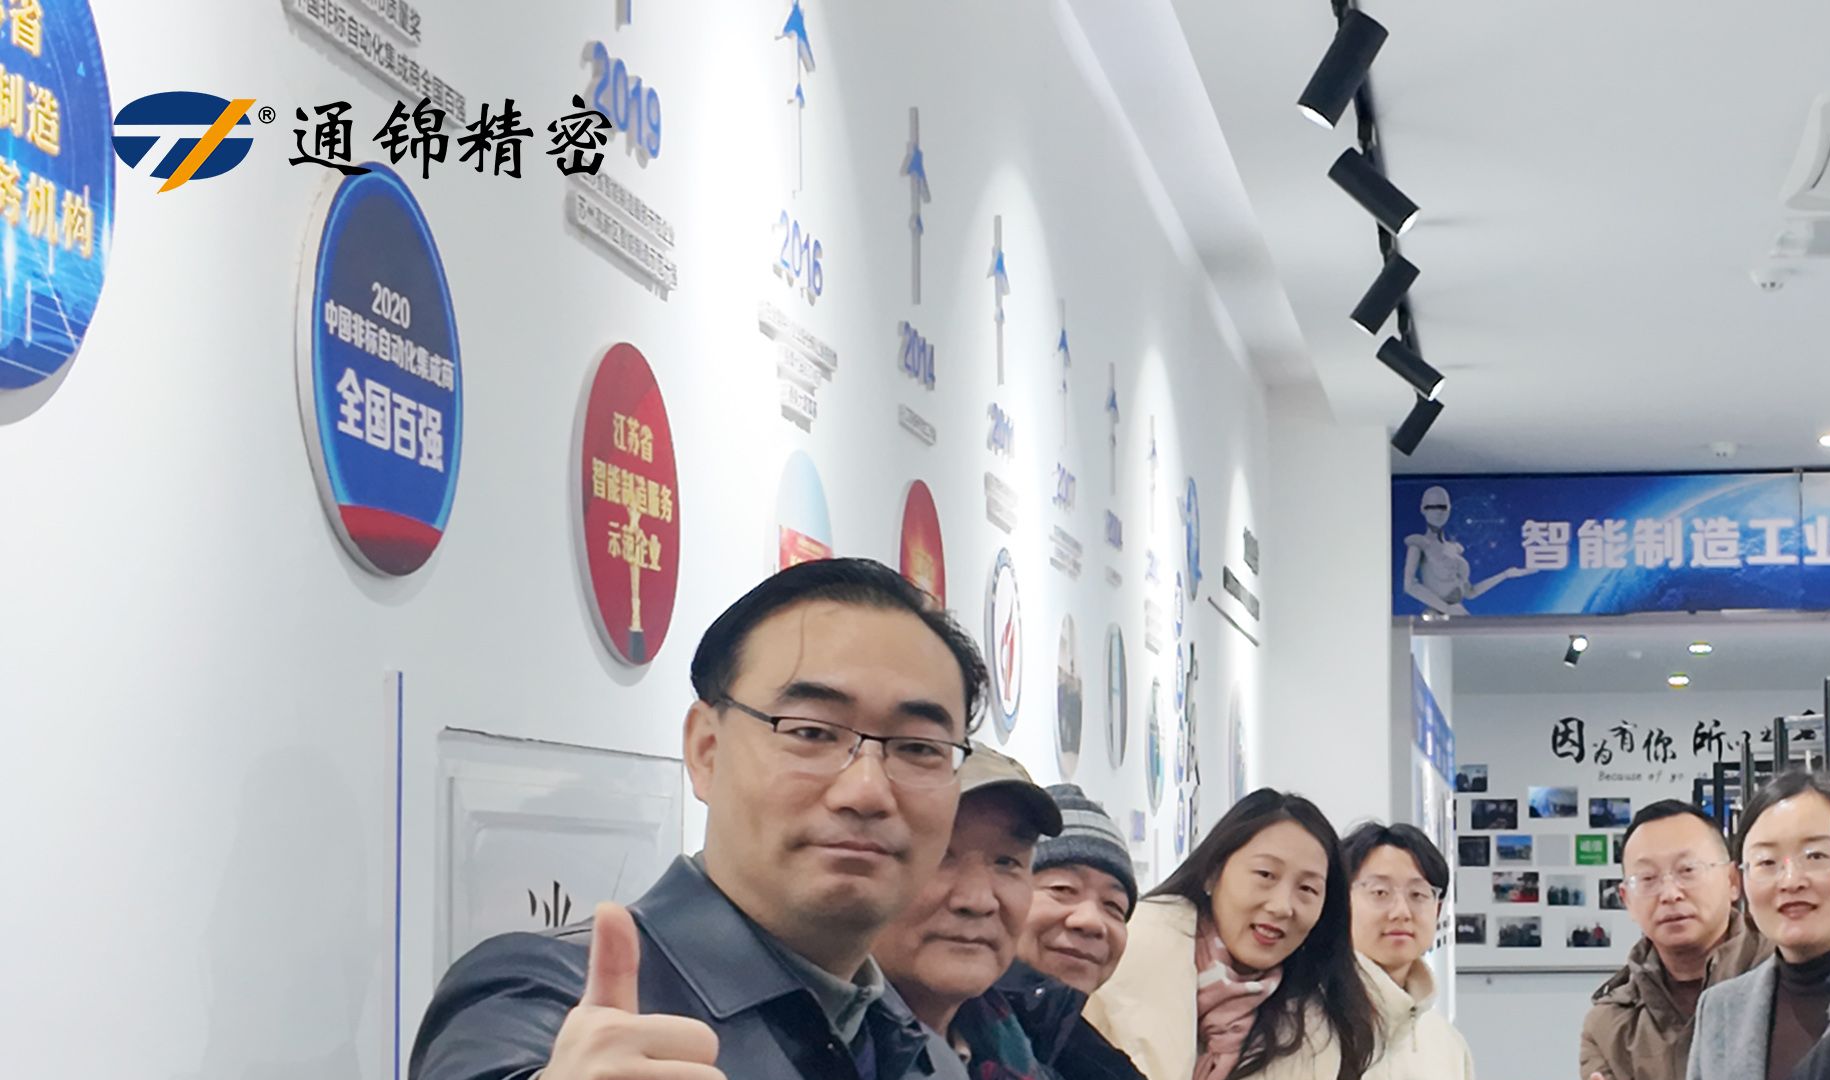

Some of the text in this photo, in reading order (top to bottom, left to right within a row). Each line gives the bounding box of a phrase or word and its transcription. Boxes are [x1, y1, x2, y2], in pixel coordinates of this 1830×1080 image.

[779, 208, 823, 297] 2016
[371, 281, 410, 329] 2020
[325, 299, 454, 392] 中国非标自动化集成商
[336, 367, 444, 472] 全国百强
[612, 411, 653, 463] 江苏省
[592, 457, 673, 523] 智能制造服务
[608, 521, 662, 571] 示范企业
